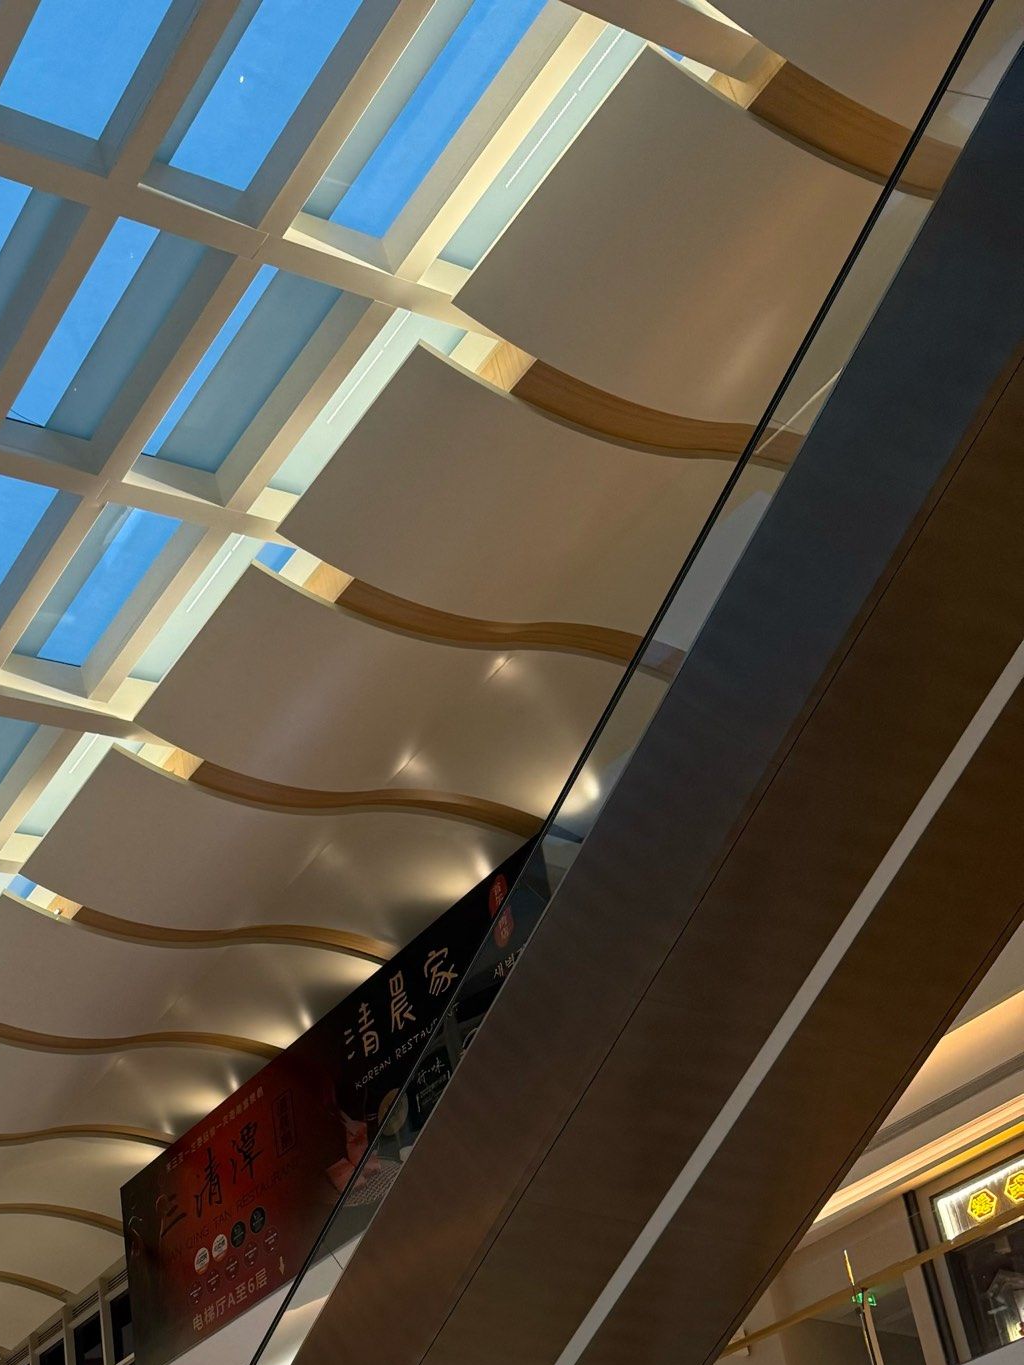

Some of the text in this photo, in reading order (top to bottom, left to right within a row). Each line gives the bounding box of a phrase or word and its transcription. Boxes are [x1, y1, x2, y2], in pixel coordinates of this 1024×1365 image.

[343, 947, 458, 1060] 清晨家
[354, 1056, 391, 1090] KOREAN
[192, 1267, 268, 1332] 电梯厅A至6层
